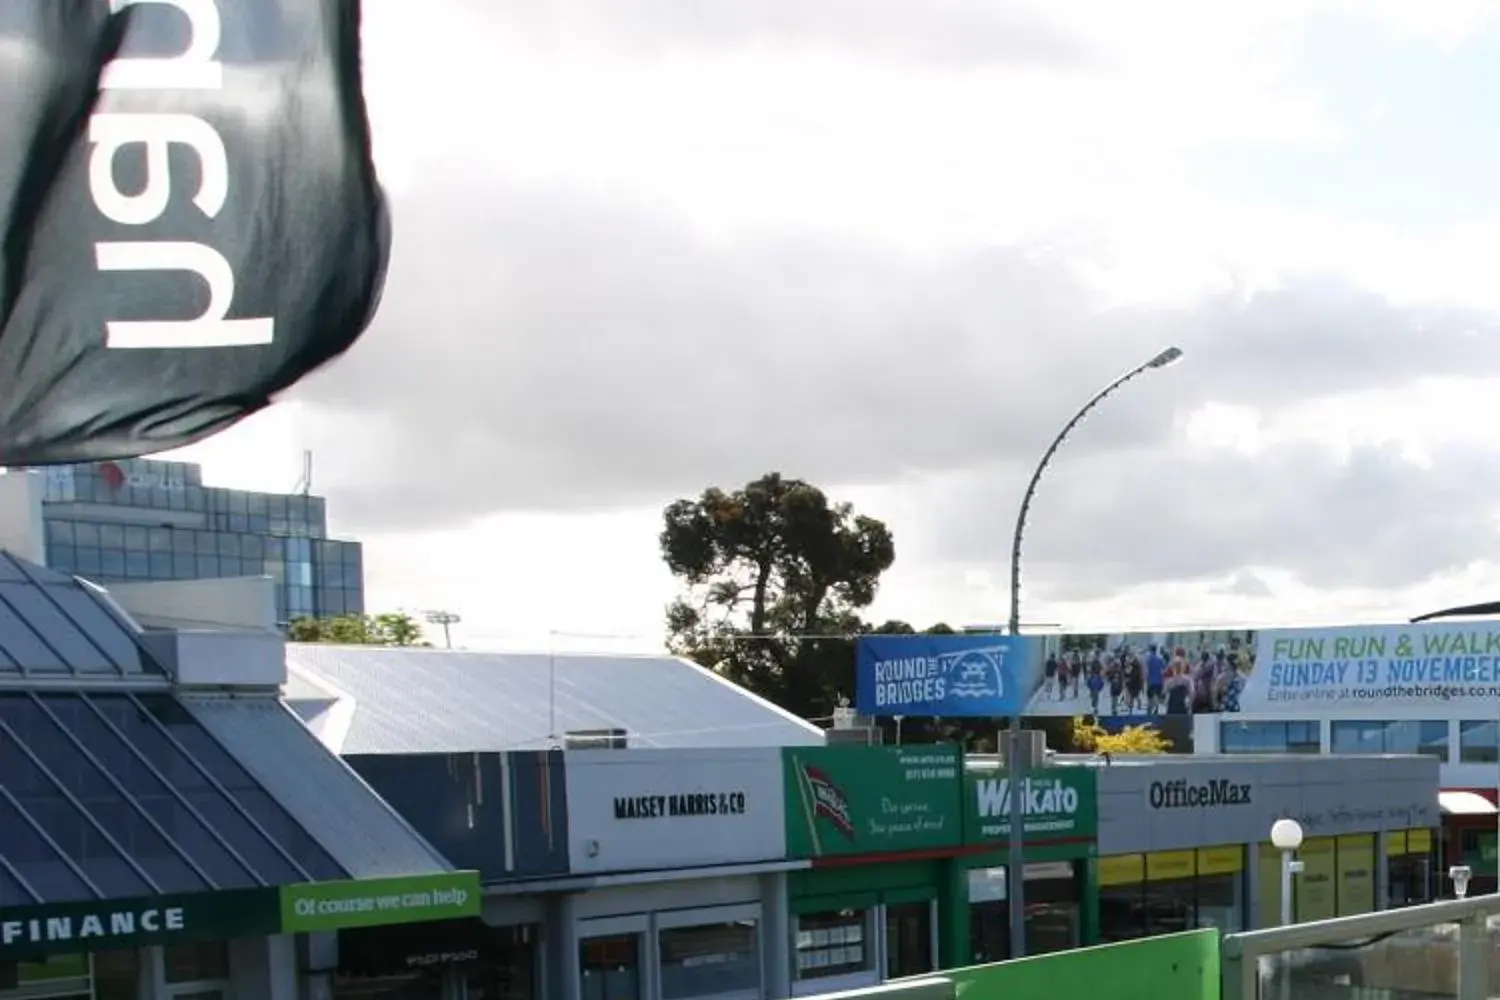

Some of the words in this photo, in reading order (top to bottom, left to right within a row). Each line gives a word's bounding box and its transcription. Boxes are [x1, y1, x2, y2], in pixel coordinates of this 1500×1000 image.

[1273, 638, 1325, 660] FUN
[1334, 636, 1386, 658] RUN
[1395, 633, 1413, 656] &
[875, 657, 926, 683] ROUND
[1270, 660, 1348, 687] SUNDAY
[1357, 660, 1377, 684] 13
[876, 678, 945, 708] BRIDGES
[613, 795, 666, 820] MAISEY
[668, 792, 717, 817] HARRIS
[1150, 777, 1252, 809] OfficeMax
[317, 896, 375, 914] course
[376, 896, 401, 909] we
[402, 892, 430, 907] can
[433, 887, 468, 907] help
[2, 907, 184, 944] FINANCE
